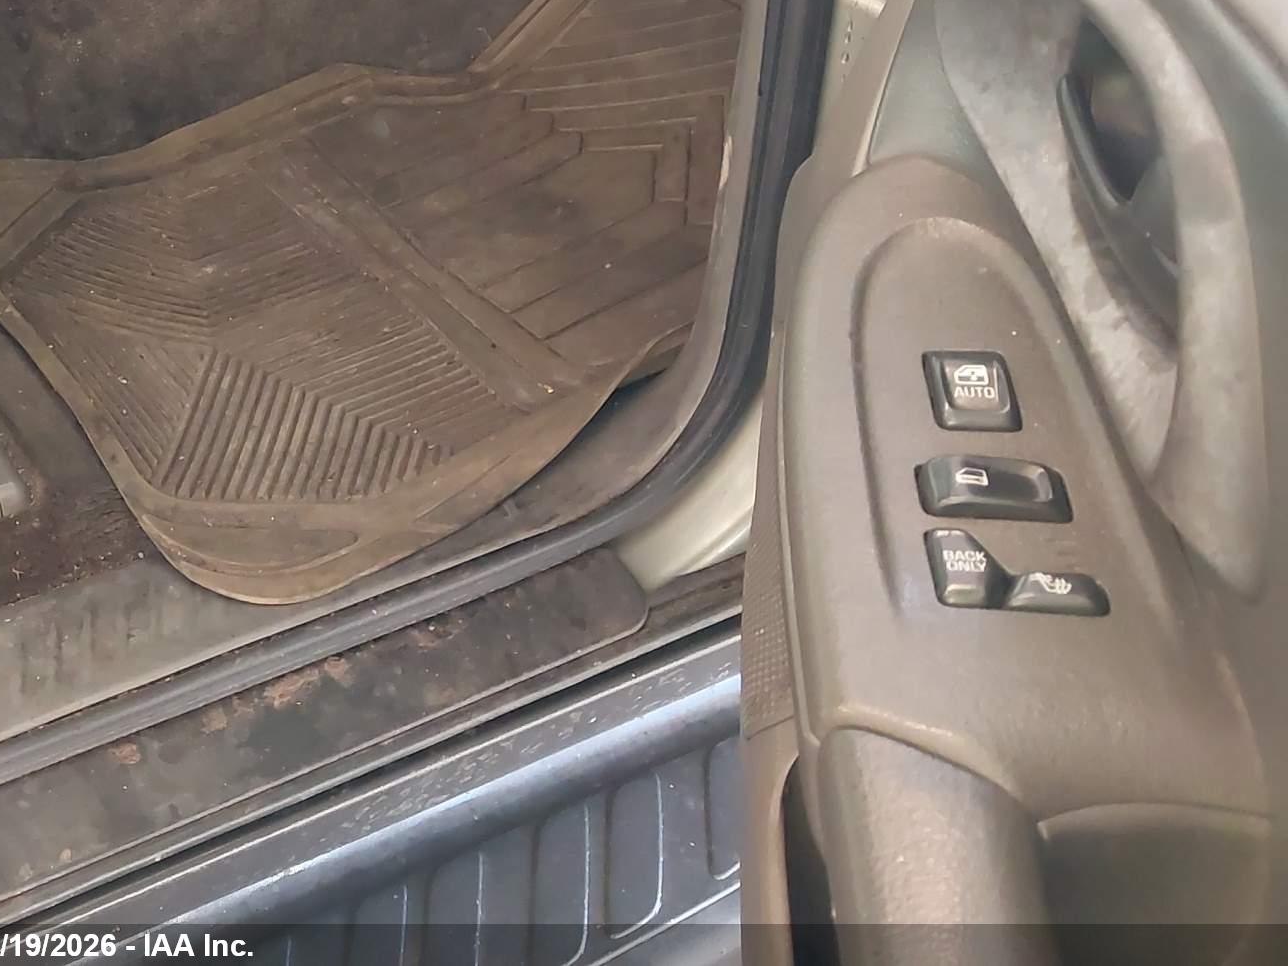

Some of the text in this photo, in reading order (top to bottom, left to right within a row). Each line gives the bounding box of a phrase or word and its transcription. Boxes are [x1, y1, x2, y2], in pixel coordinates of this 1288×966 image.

[954, 386, 995, 399] AUTO
[943, 550, 987, 561] BACK
[946, 560, 987, 572] ONLY
